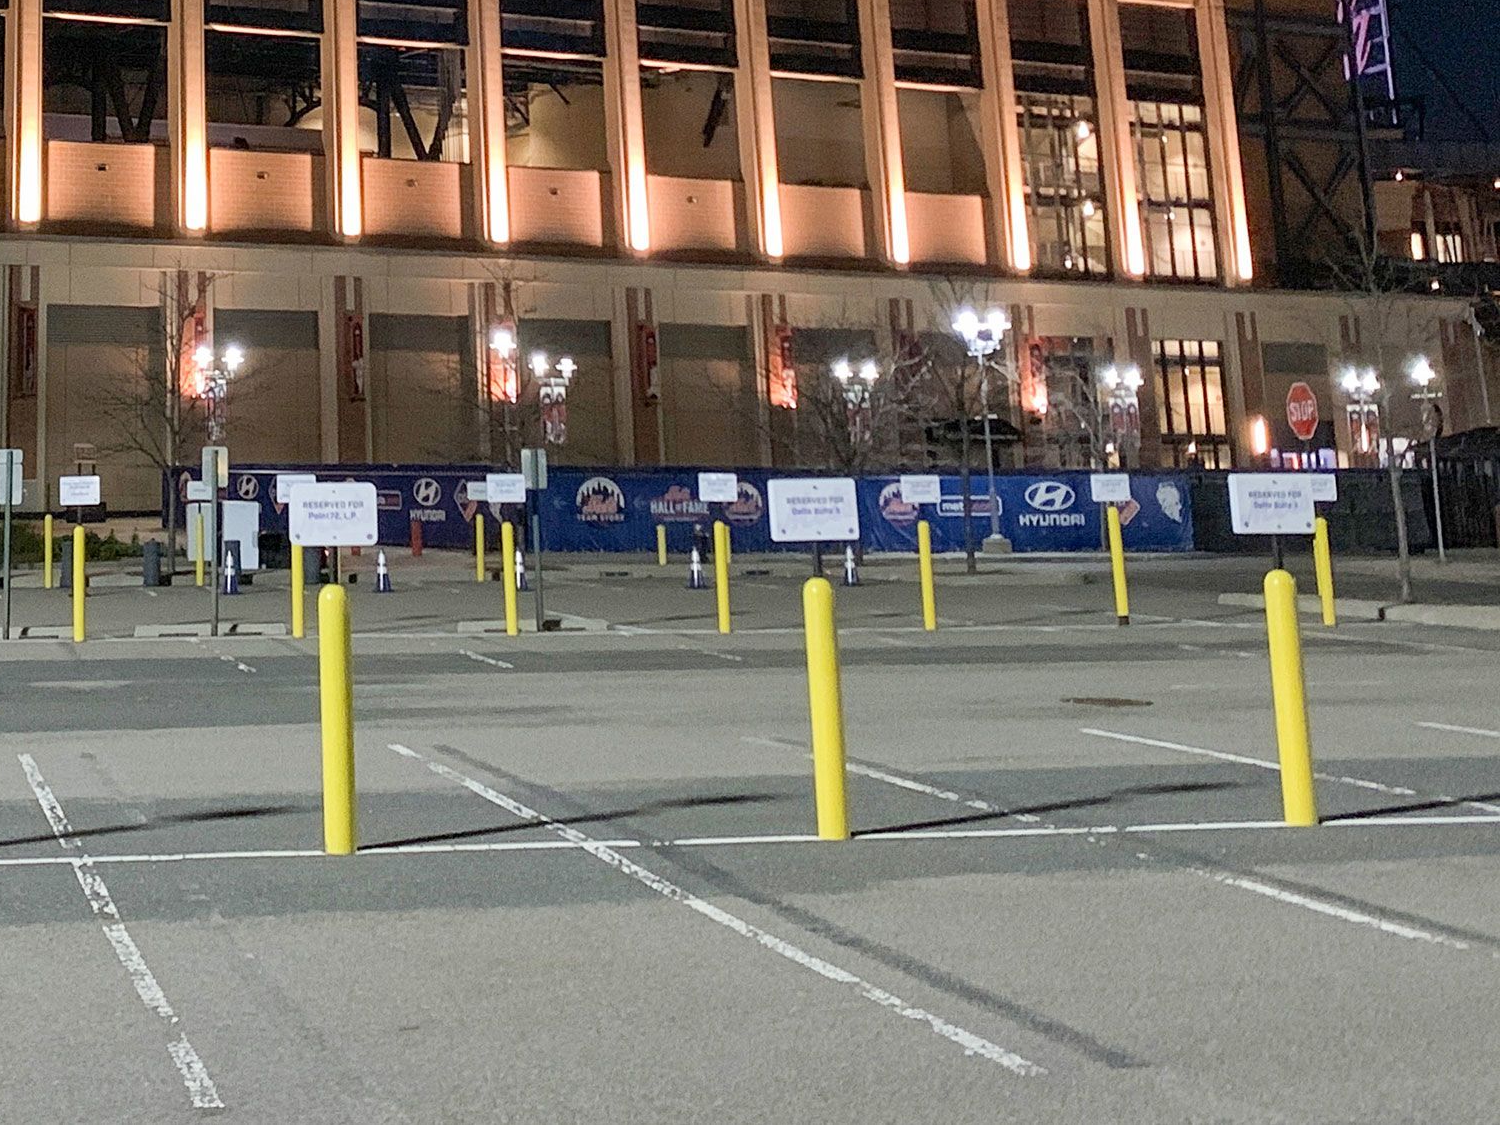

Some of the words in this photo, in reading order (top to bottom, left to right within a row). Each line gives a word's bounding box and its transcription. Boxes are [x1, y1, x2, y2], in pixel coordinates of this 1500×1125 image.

[1289, 400, 1314, 422] STOP
[303, 501, 346, 509] RESERVED
[348, 501, 364, 509] FOR
[786, 496, 828, 505] RESERVED
[650, 500, 674, 514] HALL
[682, 500, 710, 514] FAME
[576, 513, 598, 522] TEAM
[599, 513, 625, 522] STORE
[1019, 514, 1085, 526] HYUNDAI
